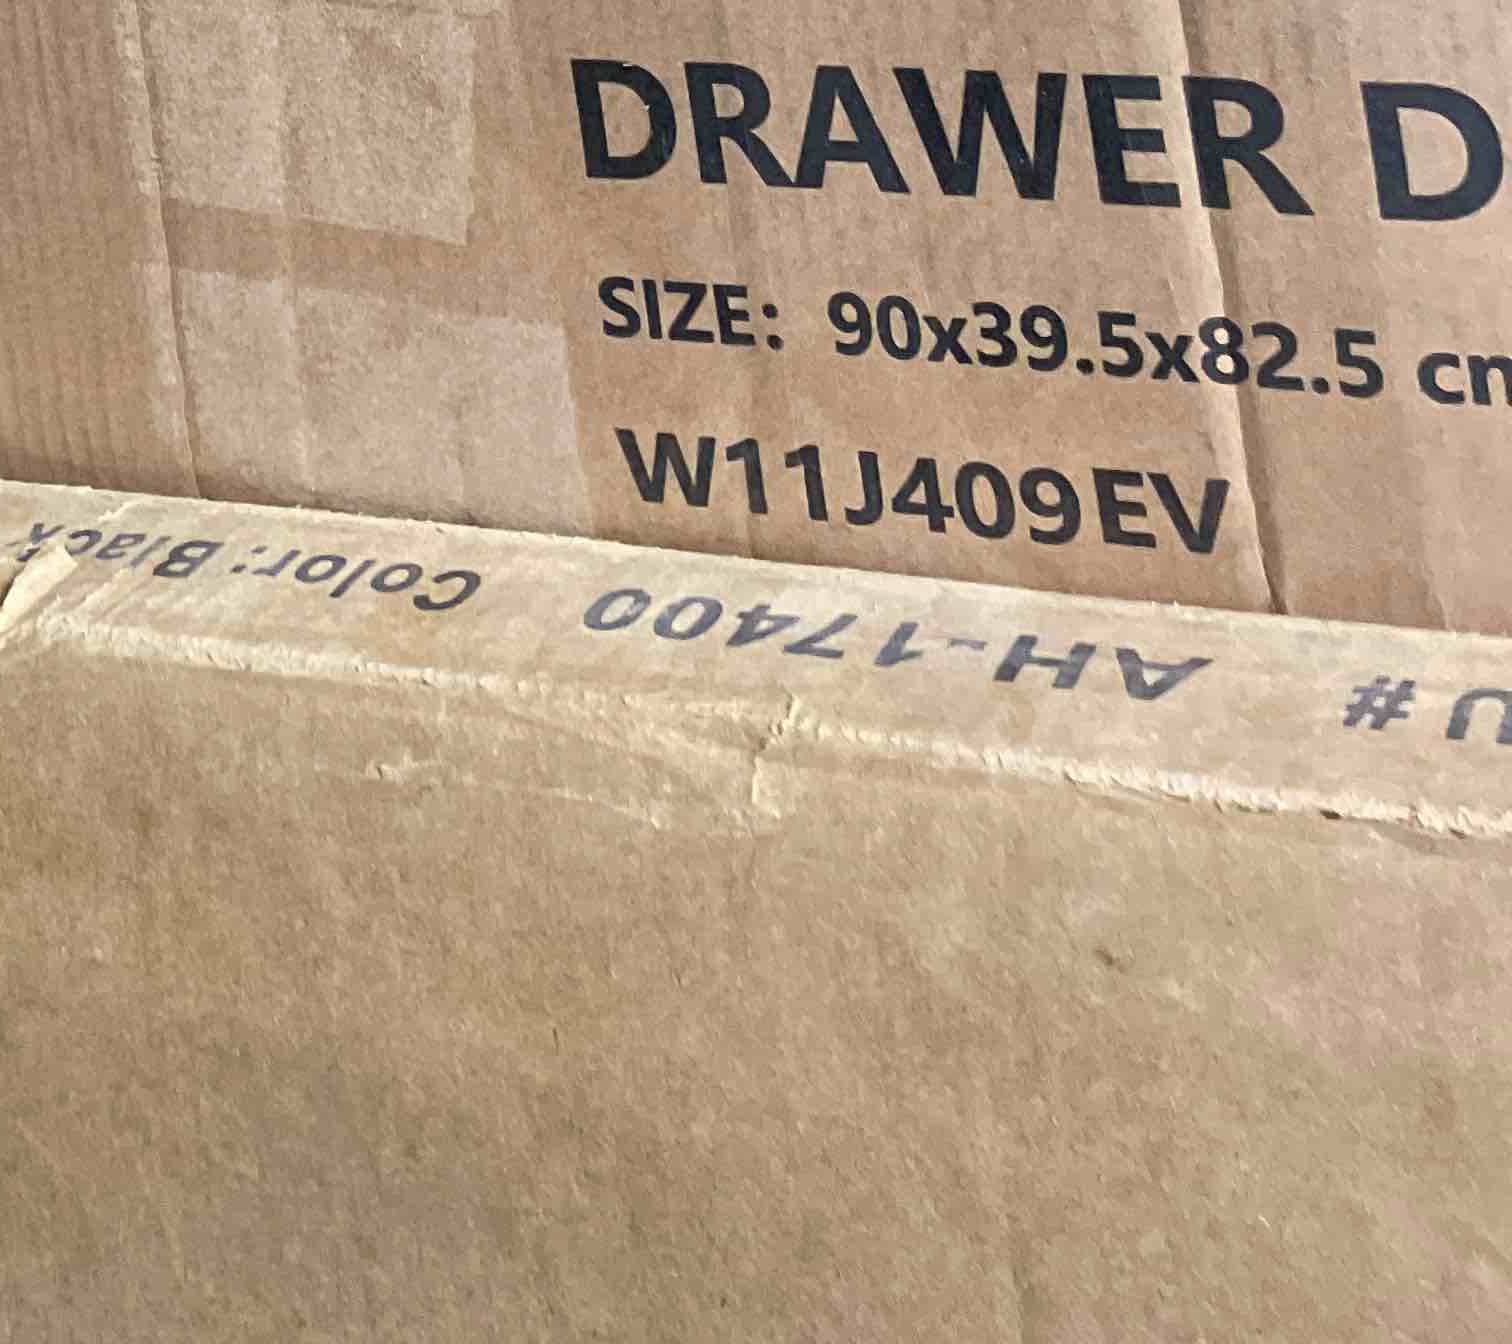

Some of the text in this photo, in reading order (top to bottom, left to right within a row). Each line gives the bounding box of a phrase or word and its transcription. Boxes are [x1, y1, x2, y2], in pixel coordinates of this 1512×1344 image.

[570, 57, 1316, 217] DRAWER
[598, 275, 784, 351] SIZE:
[827, 289, 1385, 399] 90x39.5x82.5
[615, 427, 1232, 555] W11J409EV
[229, 544, 482, 612] Color:
[583, 588, 1215, 702] AH-17400
